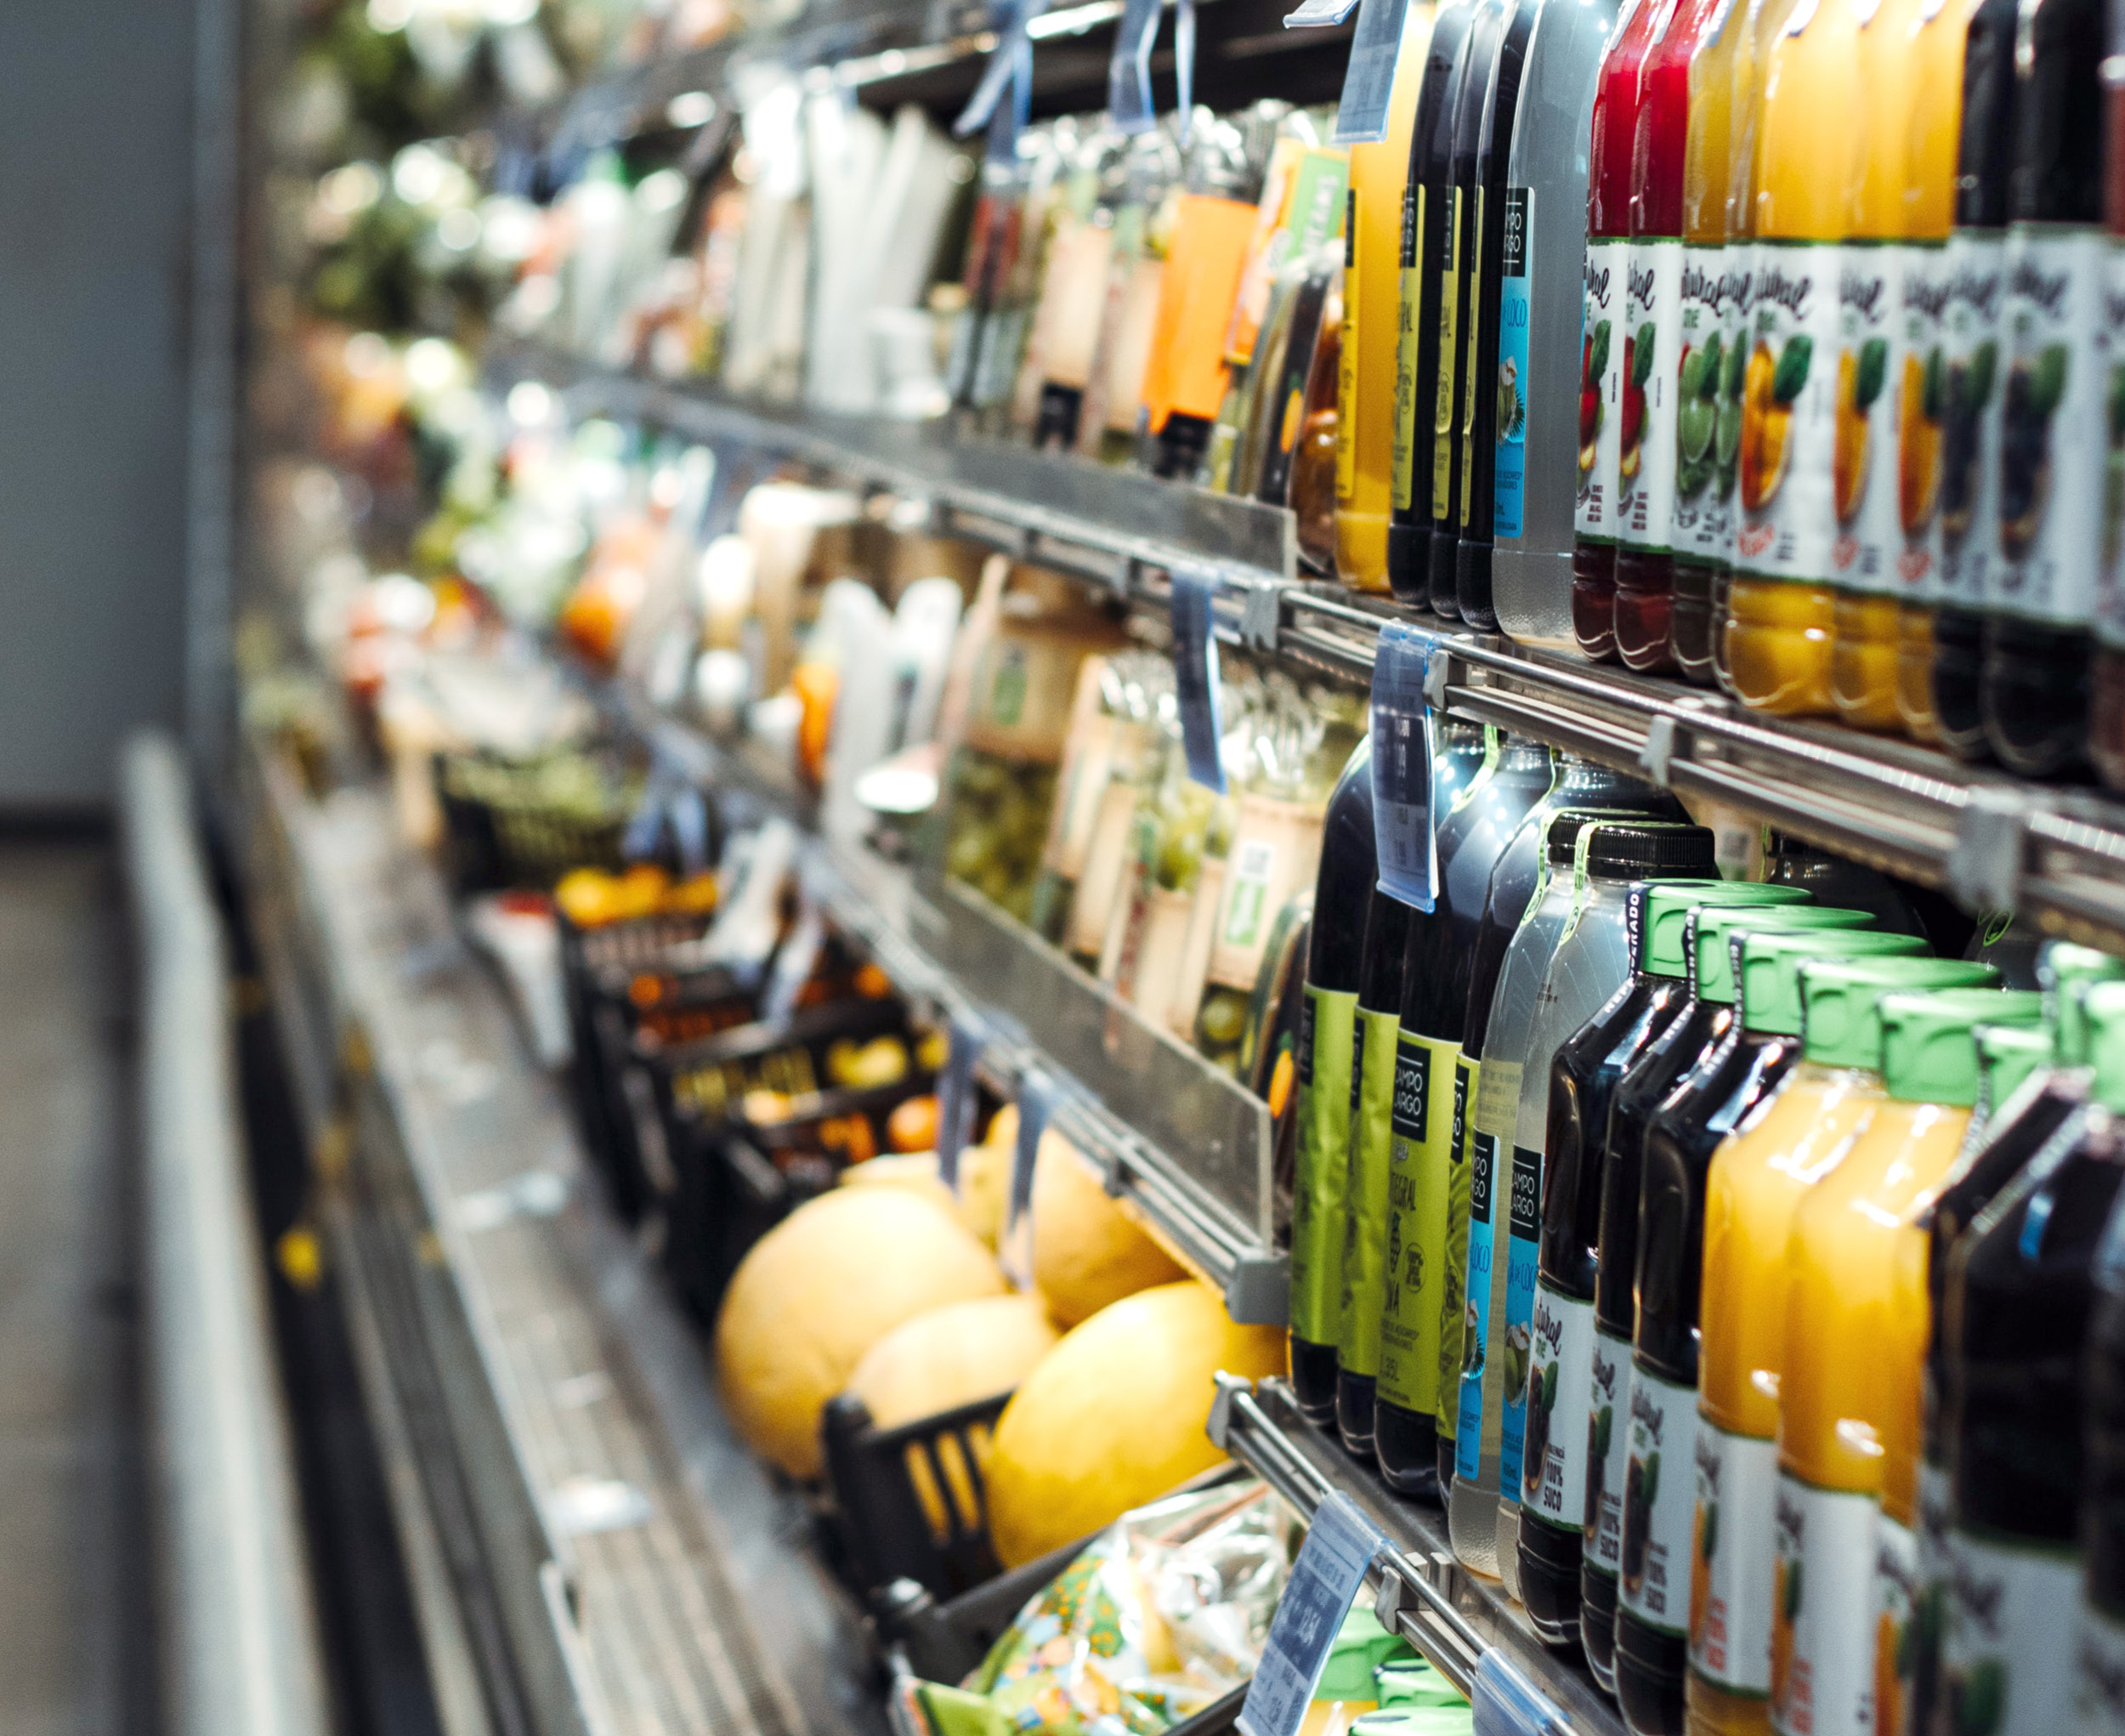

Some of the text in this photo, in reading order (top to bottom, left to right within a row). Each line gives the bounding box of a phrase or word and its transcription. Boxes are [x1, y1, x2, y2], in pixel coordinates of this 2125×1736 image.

[1472, 1154, 1488, 1177] PO
[1471, 1176, 1486, 1198] GO
[1521, 1262, 1537, 1293] COC
[1545, 1461, 1564, 1488] 100%
[1543, 1484, 1562, 1513] SUCO
